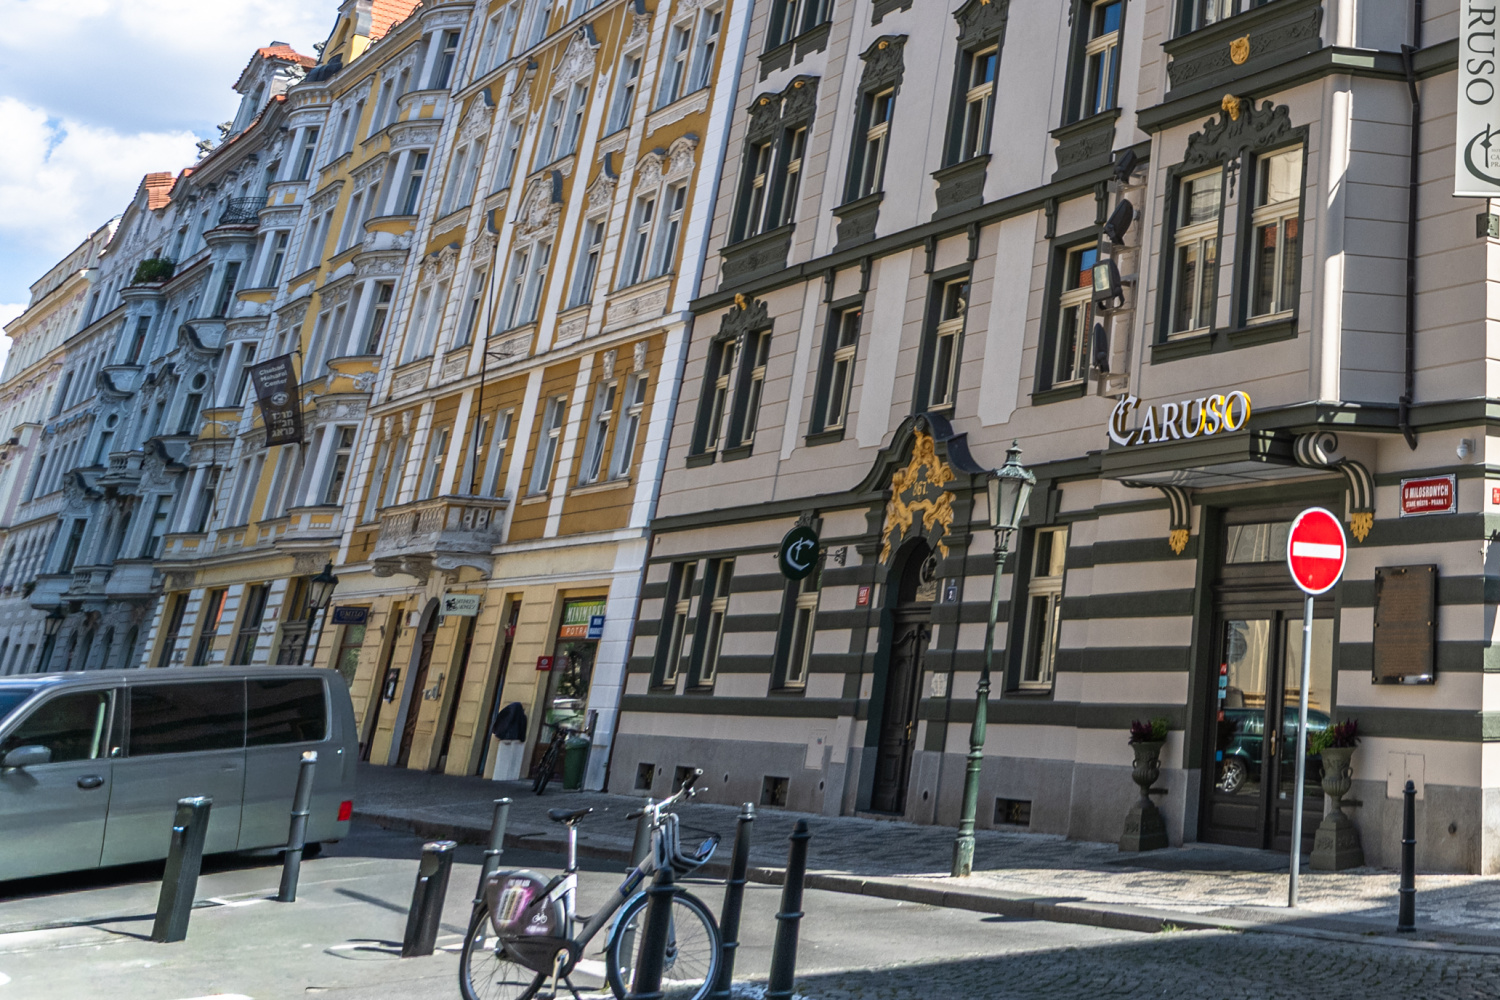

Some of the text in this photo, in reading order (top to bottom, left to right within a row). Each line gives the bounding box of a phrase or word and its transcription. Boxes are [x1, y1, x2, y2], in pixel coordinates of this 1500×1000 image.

[259, 364, 285, 376] Chabad
[260, 370, 287, 382] Maharal
[264, 378, 287, 388] Center
[1108, 390, 1250, 446] CARUSO
[1405, 483, 1448, 499] U MILOSRDNÝCH
